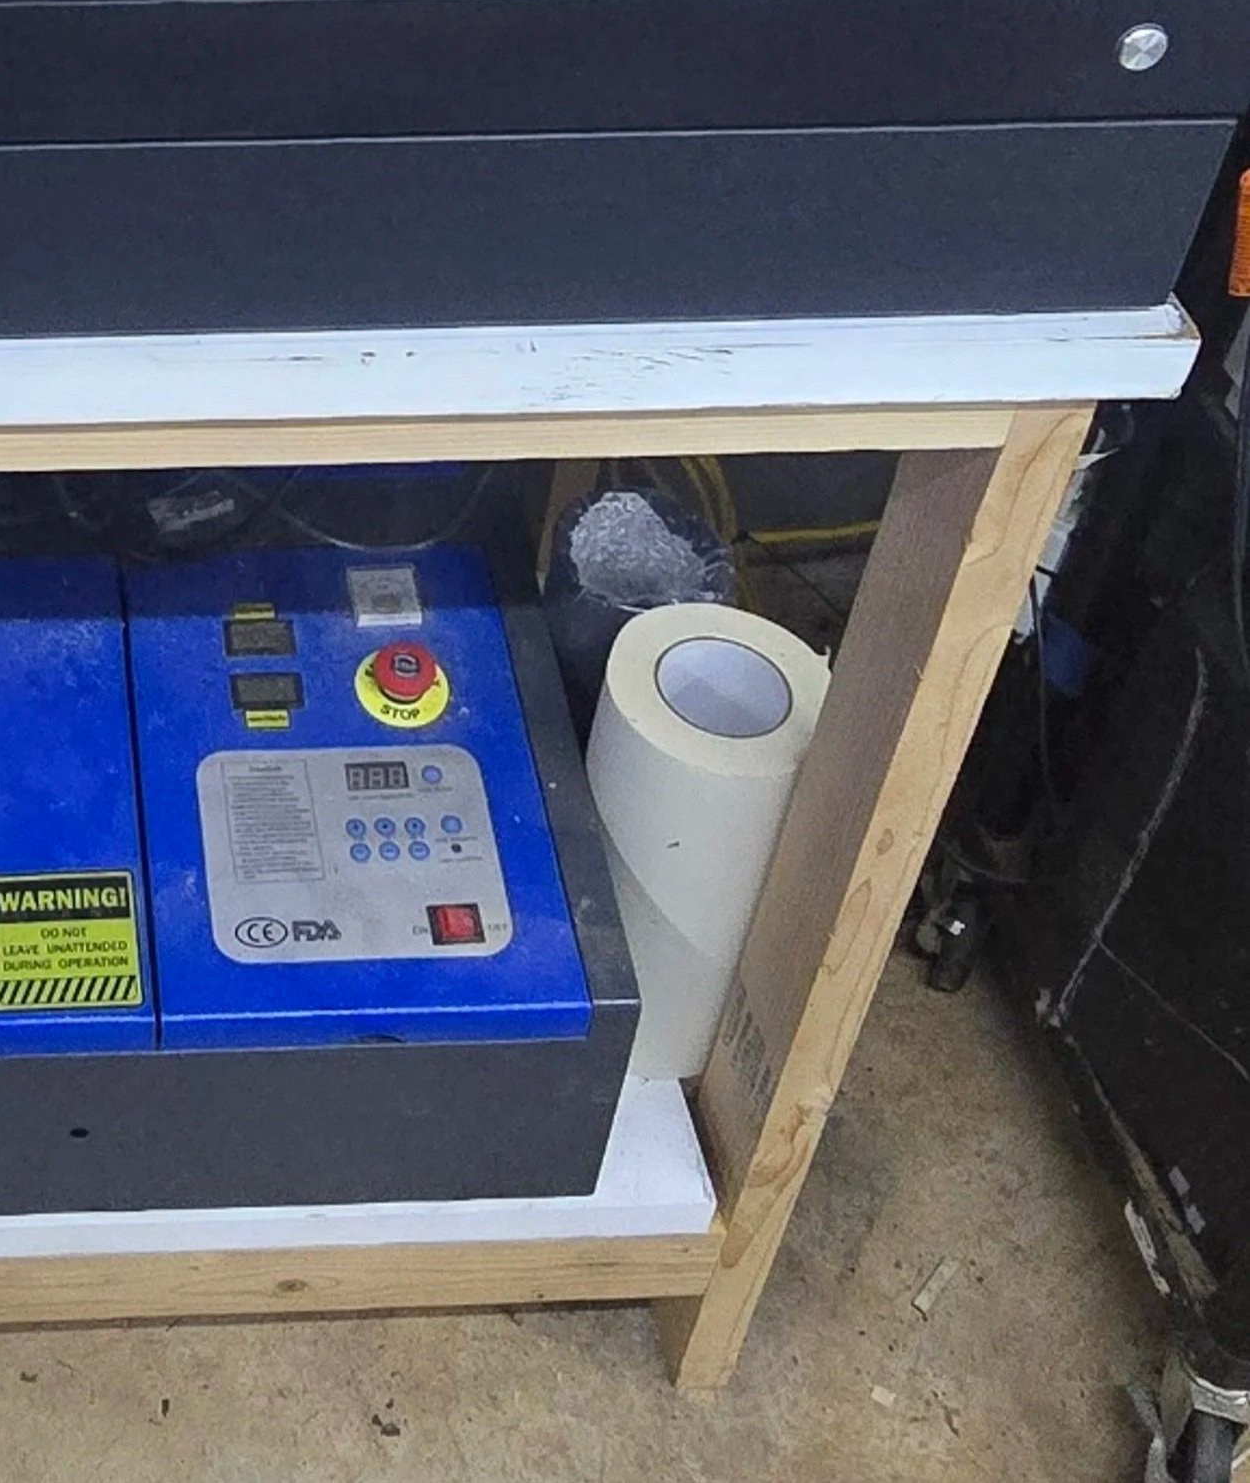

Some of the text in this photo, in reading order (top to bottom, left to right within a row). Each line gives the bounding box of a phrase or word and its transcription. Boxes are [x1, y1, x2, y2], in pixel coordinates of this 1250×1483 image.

[379, 703, 421, 721] STOP
[40, 927, 87, 939] DO NOT
[291, 919, 342, 941] FDA
[2, 940, 128, 957] LEAVE UNATTENDED
[2, 955, 129, 972] DURING OPERATION
